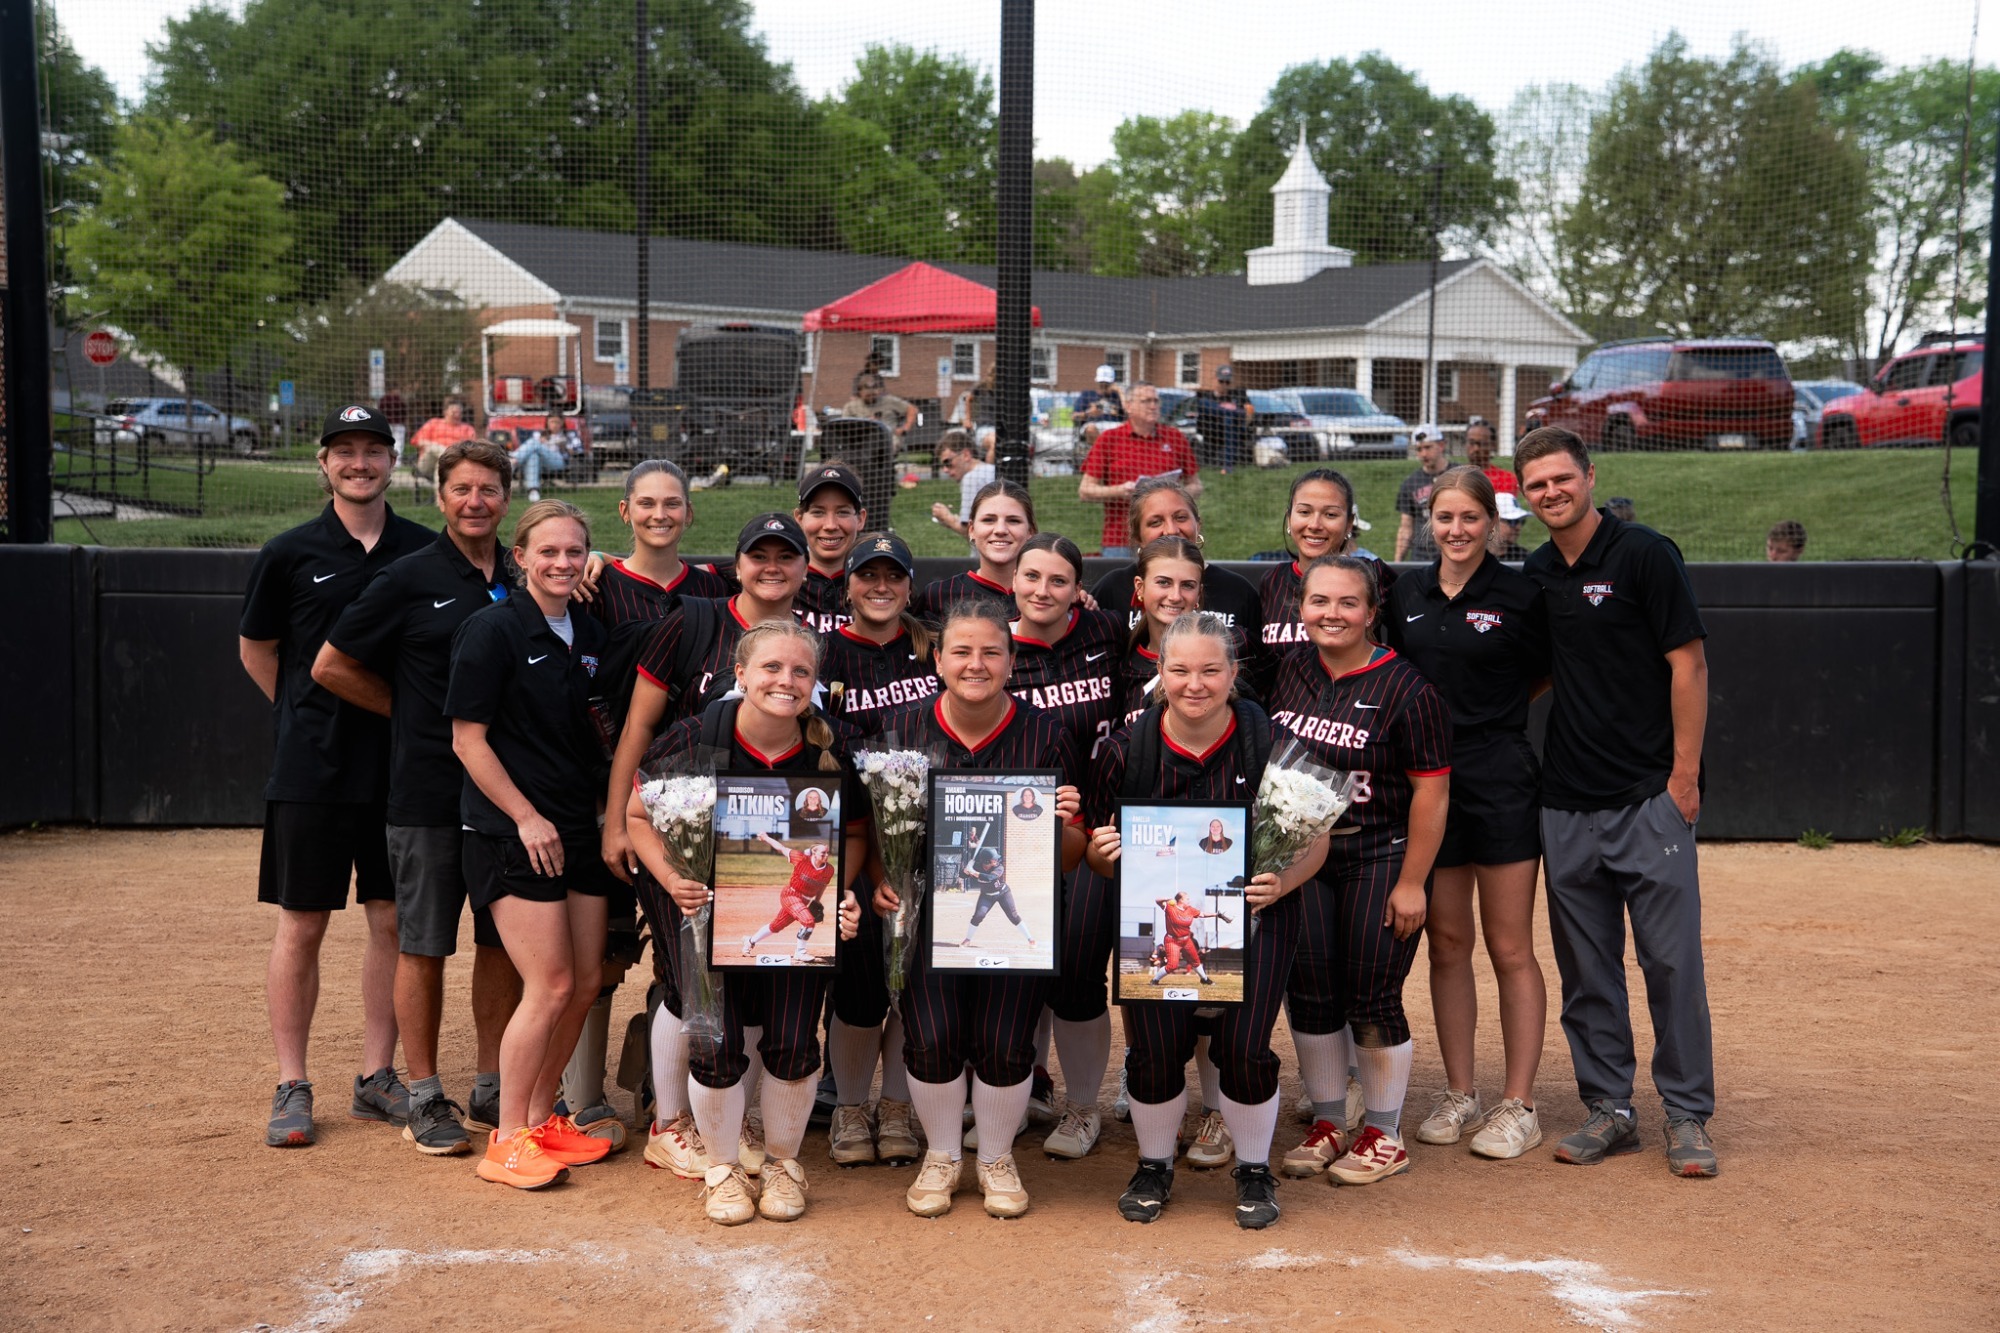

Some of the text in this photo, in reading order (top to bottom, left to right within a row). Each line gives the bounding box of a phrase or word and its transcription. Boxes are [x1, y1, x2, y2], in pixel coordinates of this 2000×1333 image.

[1582, 585, 1613, 594] SOFTBALL
[1466, 612, 1502, 624] SOFTBALL
[1262, 622, 1310, 644] CHAR
[845, 675, 939, 713] HARGERS
[1012, 676, 1111, 709] ARGERS
[727, 794, 785, 816] ATKINS
[944, 794, 1003, 814] HOOVER
[1131, 824, 1173, 846] HUEY
